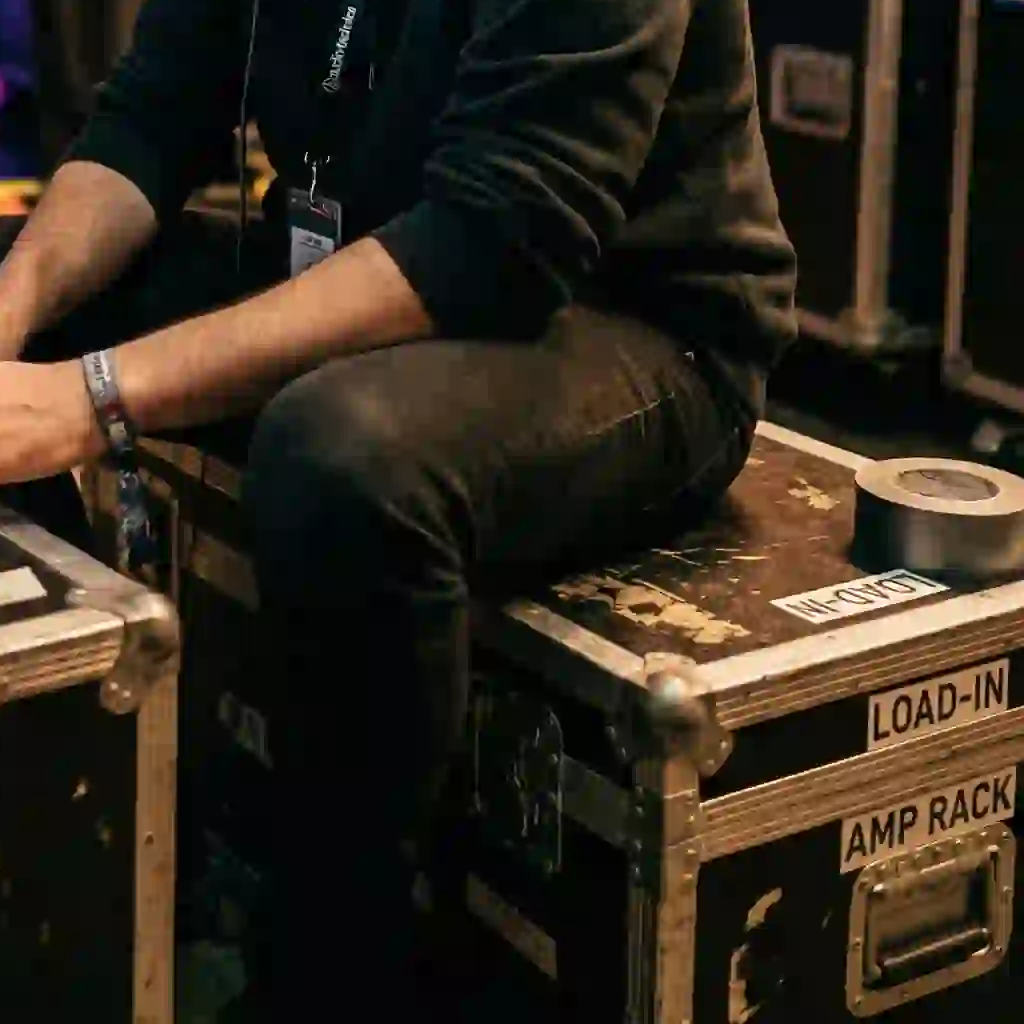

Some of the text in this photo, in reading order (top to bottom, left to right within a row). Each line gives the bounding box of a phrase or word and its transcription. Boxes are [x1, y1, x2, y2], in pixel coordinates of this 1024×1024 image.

[873, 668, 1004, 741] LOAD-IN
[844, 774, 1012, 863] AMP RACK
